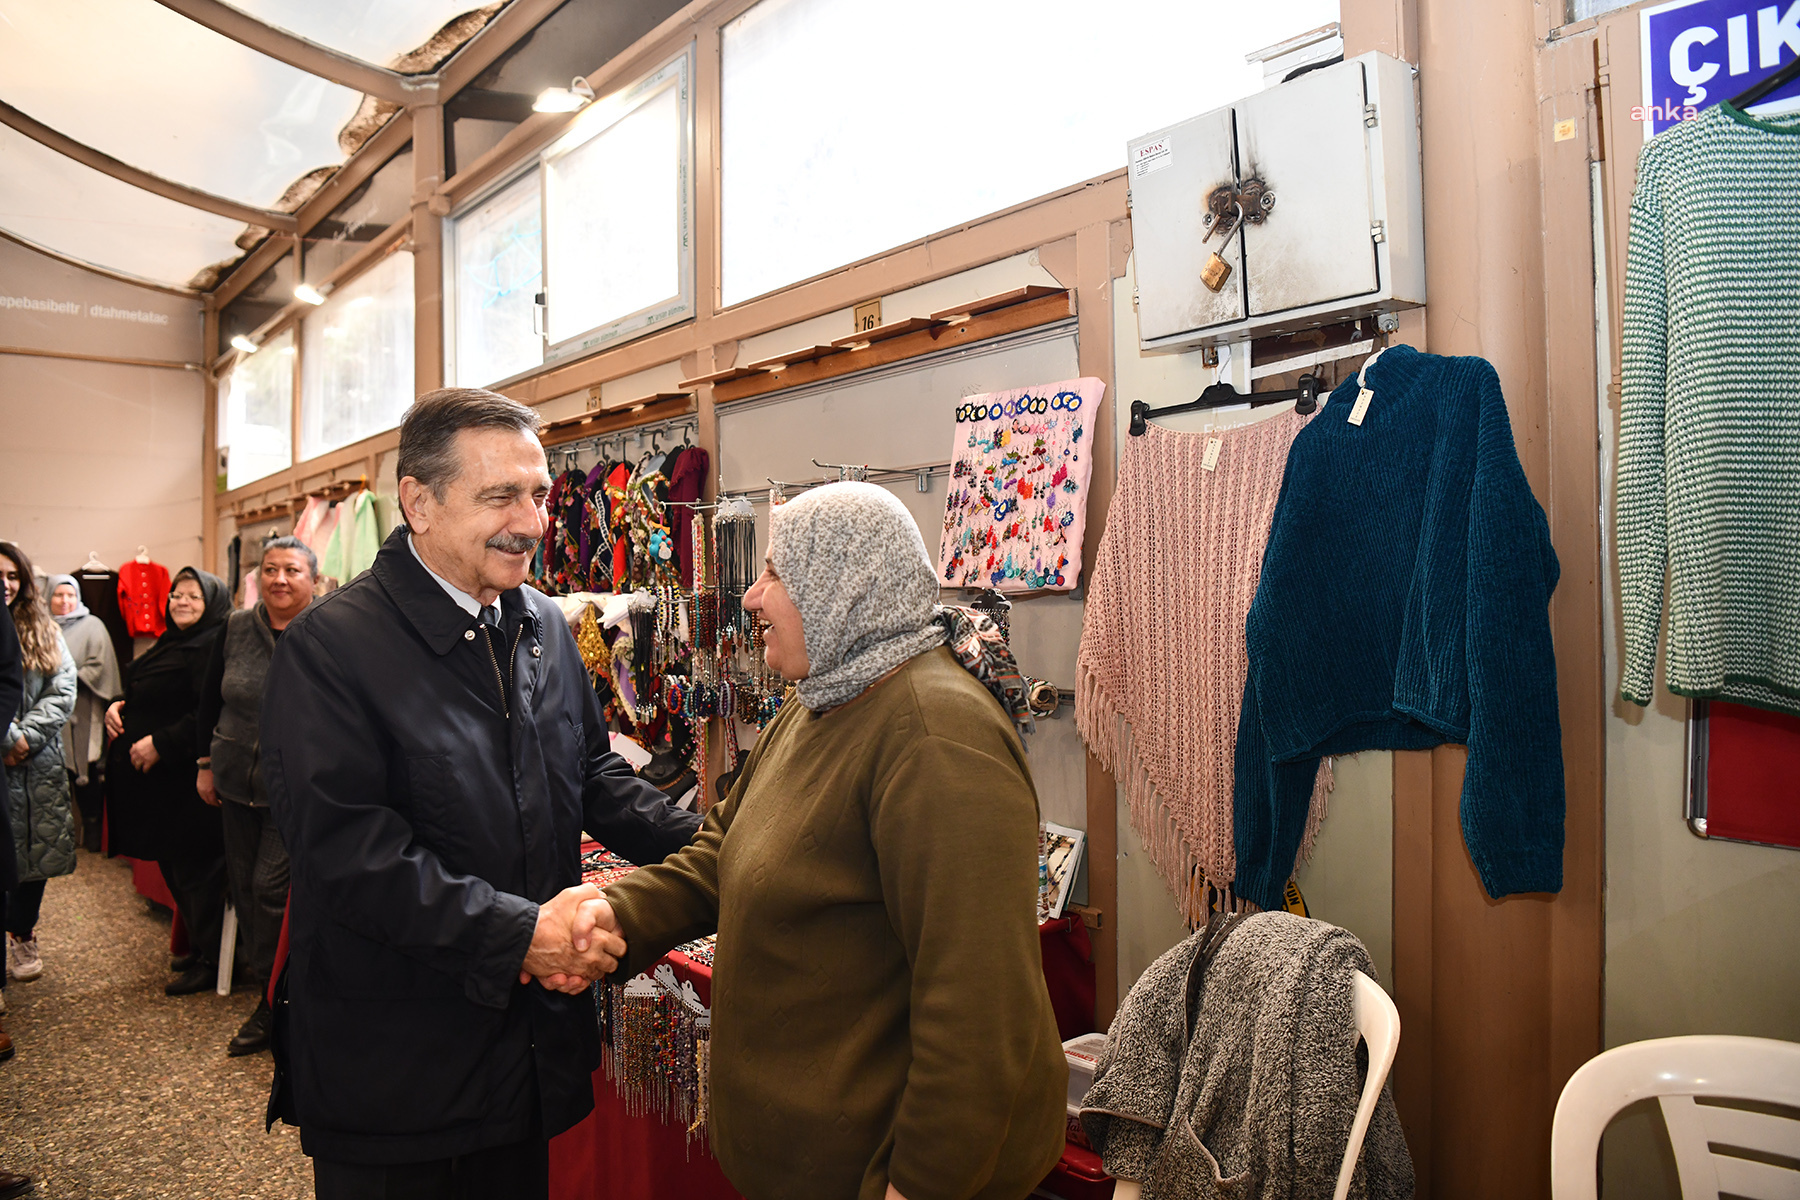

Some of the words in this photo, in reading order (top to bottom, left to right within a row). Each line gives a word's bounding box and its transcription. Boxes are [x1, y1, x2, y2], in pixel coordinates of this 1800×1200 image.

[1669, 0, 1800, 106] ÇIK
[90, 304, 169, 325] dtahmetatac
[861, 314, 875, 331] 16
